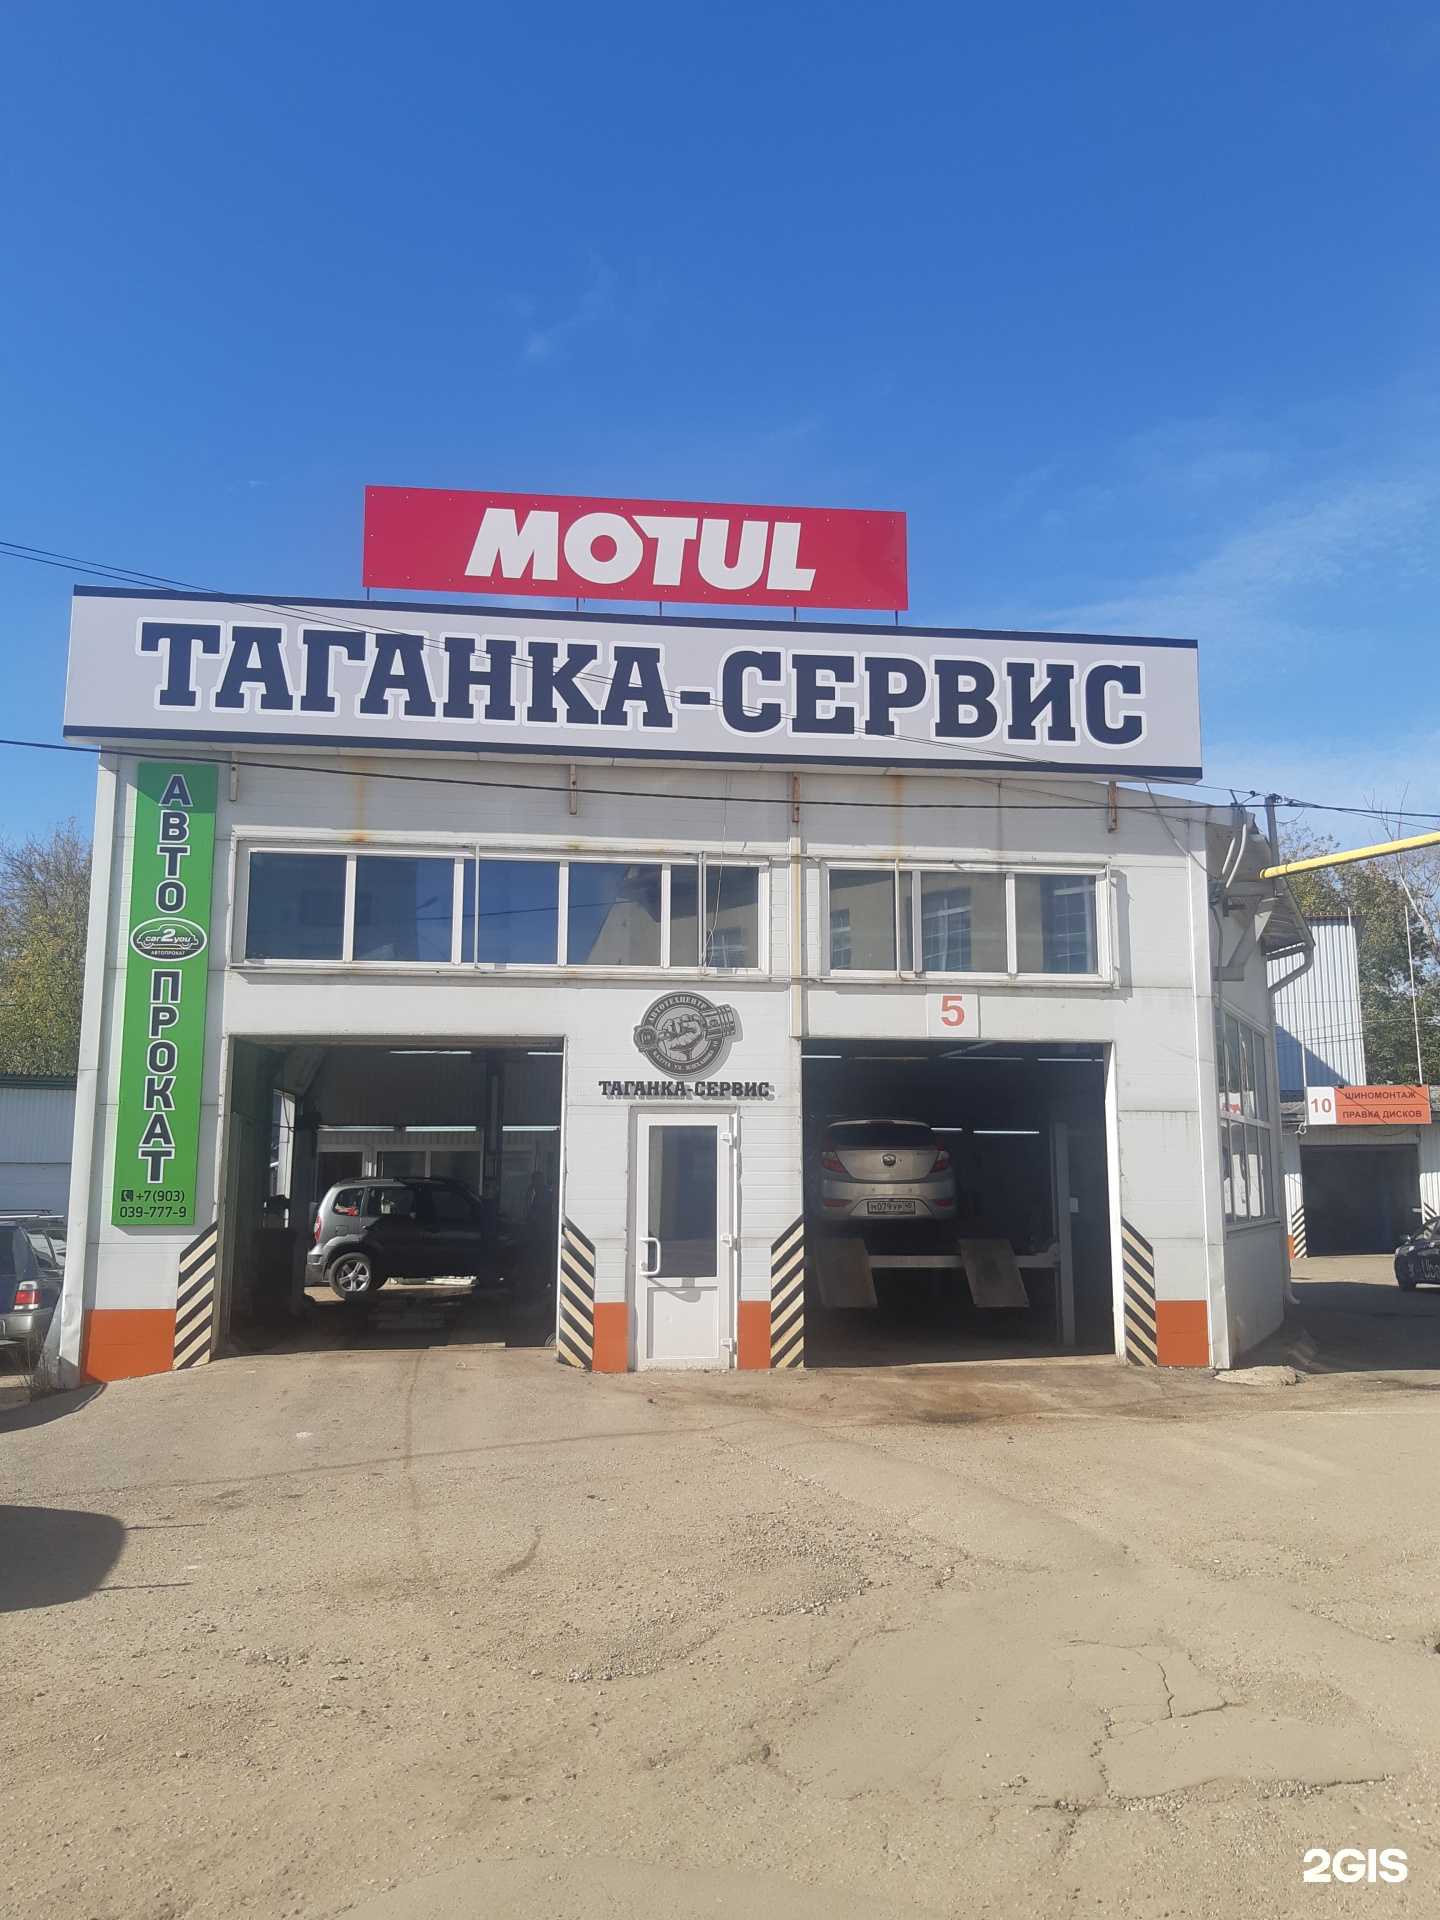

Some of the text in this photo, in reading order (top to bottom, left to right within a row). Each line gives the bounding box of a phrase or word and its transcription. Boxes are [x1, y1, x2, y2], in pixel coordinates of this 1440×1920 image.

[464, 507, 816, 591] MOTUL
[138, 619, 1145, 746] ТАГАНКА-СЕРВИС
[157, 773, 193, 914] АВТО
[940, 995, 965, 1027] 5
[138, 969, 183, 1184] ПРОКАТ
[598, 1080, 772, 1098] ТАГАНКА-СЕРВИС
[1310, 1098, 1333, 1113] 10
[1344, 1091, 1417, 1100] ШИНОМОНТАЖ
[1342, 1110, 1423, 1119] ПРАВКА ДИСКОВ
[119, 1206, 187, 1218] 039-777-9
